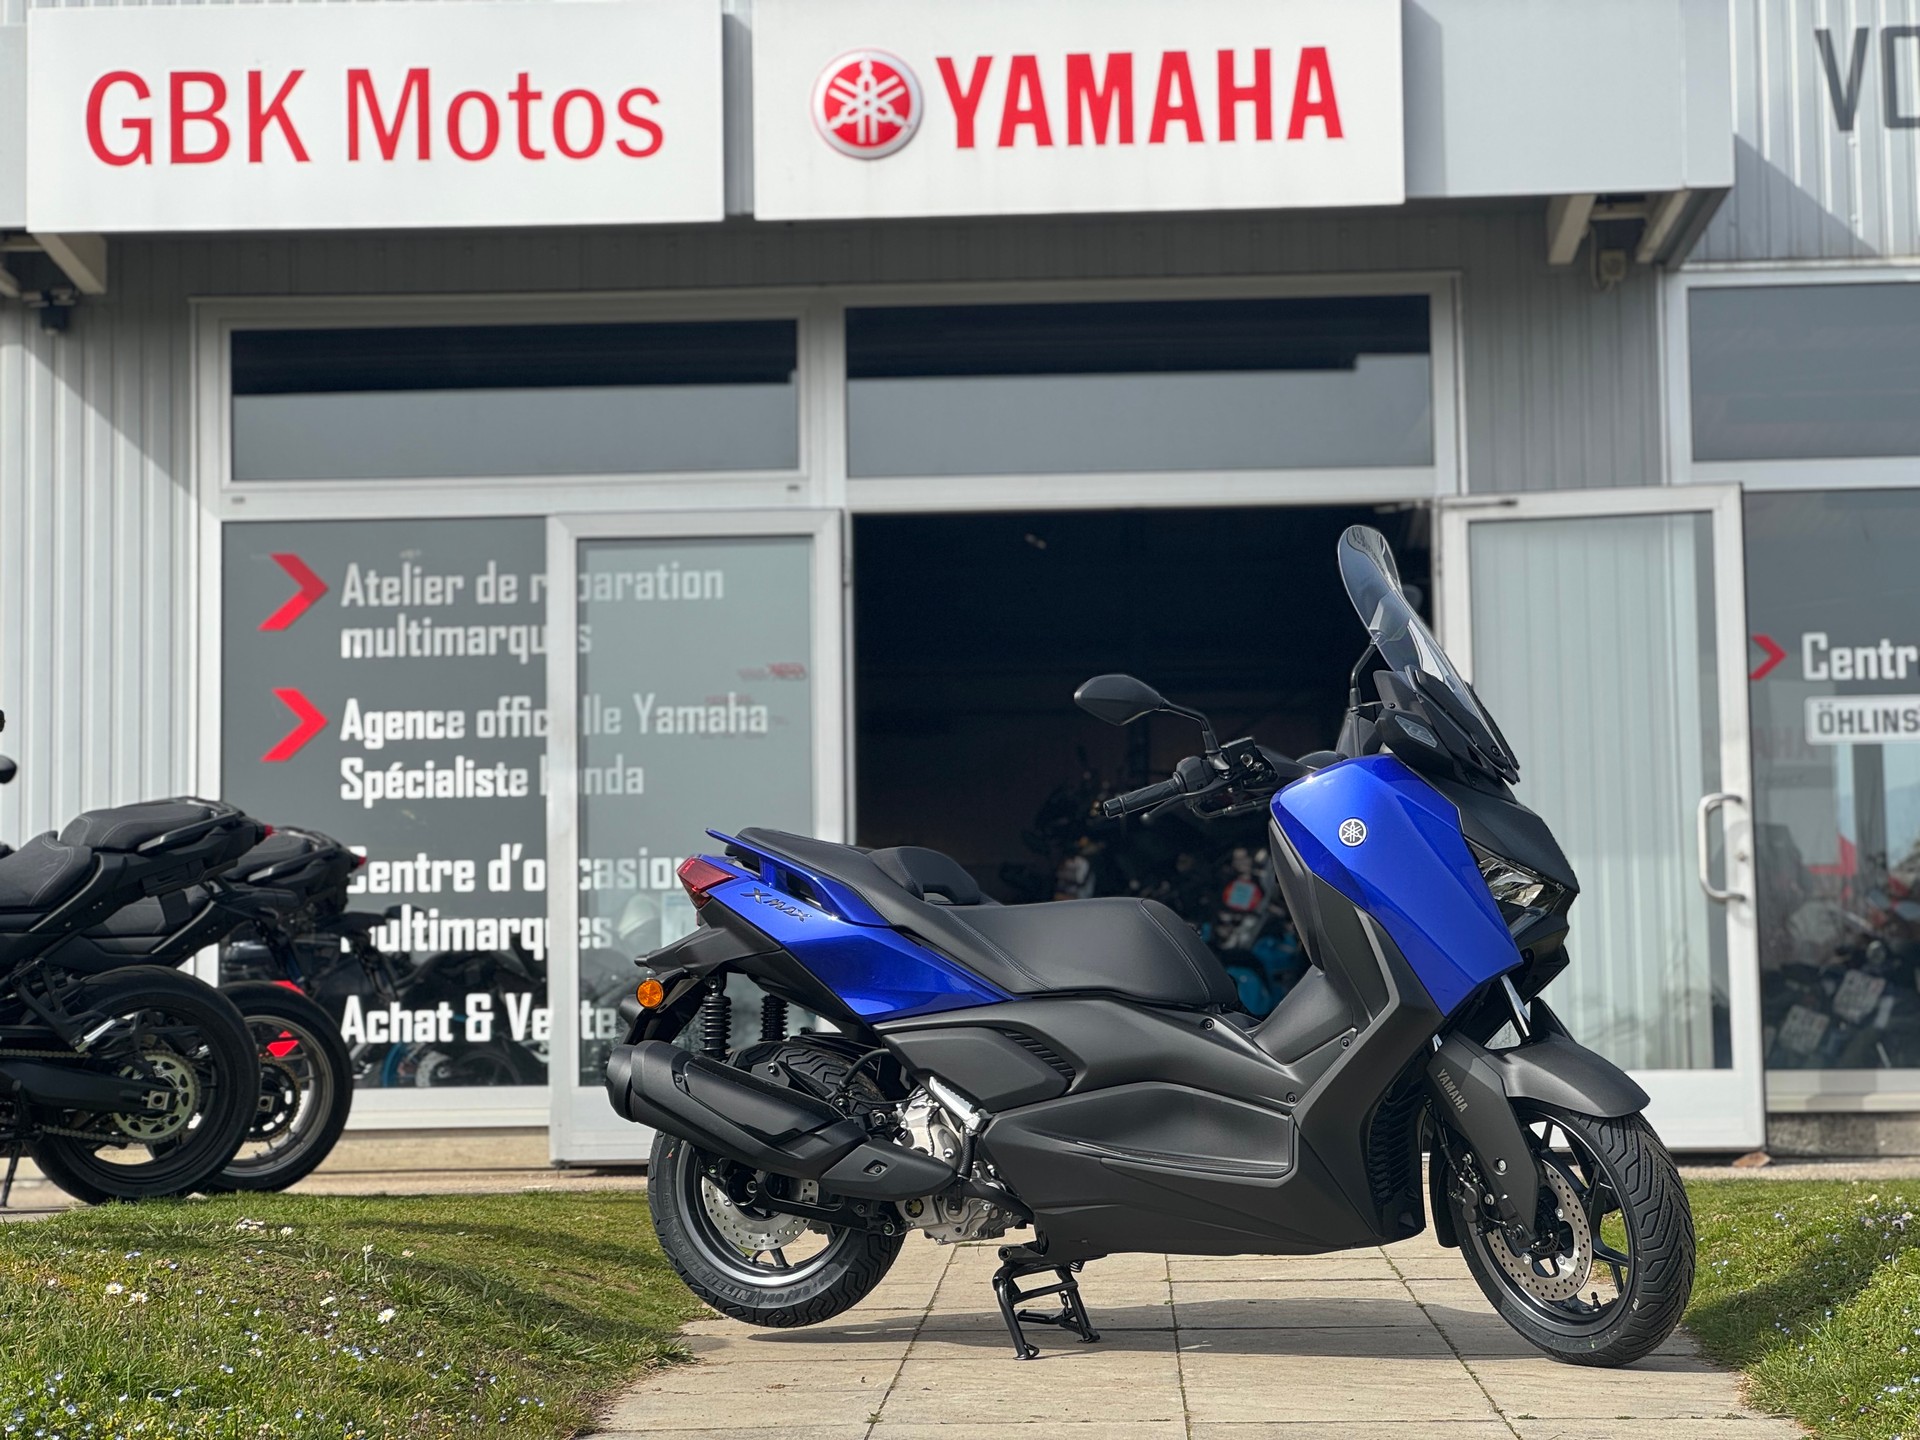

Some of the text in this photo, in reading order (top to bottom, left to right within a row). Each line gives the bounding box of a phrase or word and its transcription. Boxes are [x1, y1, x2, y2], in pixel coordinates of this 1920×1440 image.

[86, 67, 665, 166] GBK Motos
[935, 46, 1344, 149] YAMAHA
[340, 560, 724, 607] Atelier de raration
[340, 614, 593, 665] multimarqus
[340, 691, 769, 750] Agence officlle Yamaha
[1817, 702, 1920, 735] ÖHLINS
[340, 753, 644, 809] Spécialiste nda
[487, 843, 685, 893] d'ocasio
[340, 903, 613, 961] ultimarqes
[340, 992, 616, 1045] Achat & Vete
[1437, 1068, 1468, 1113] YAMAHA
